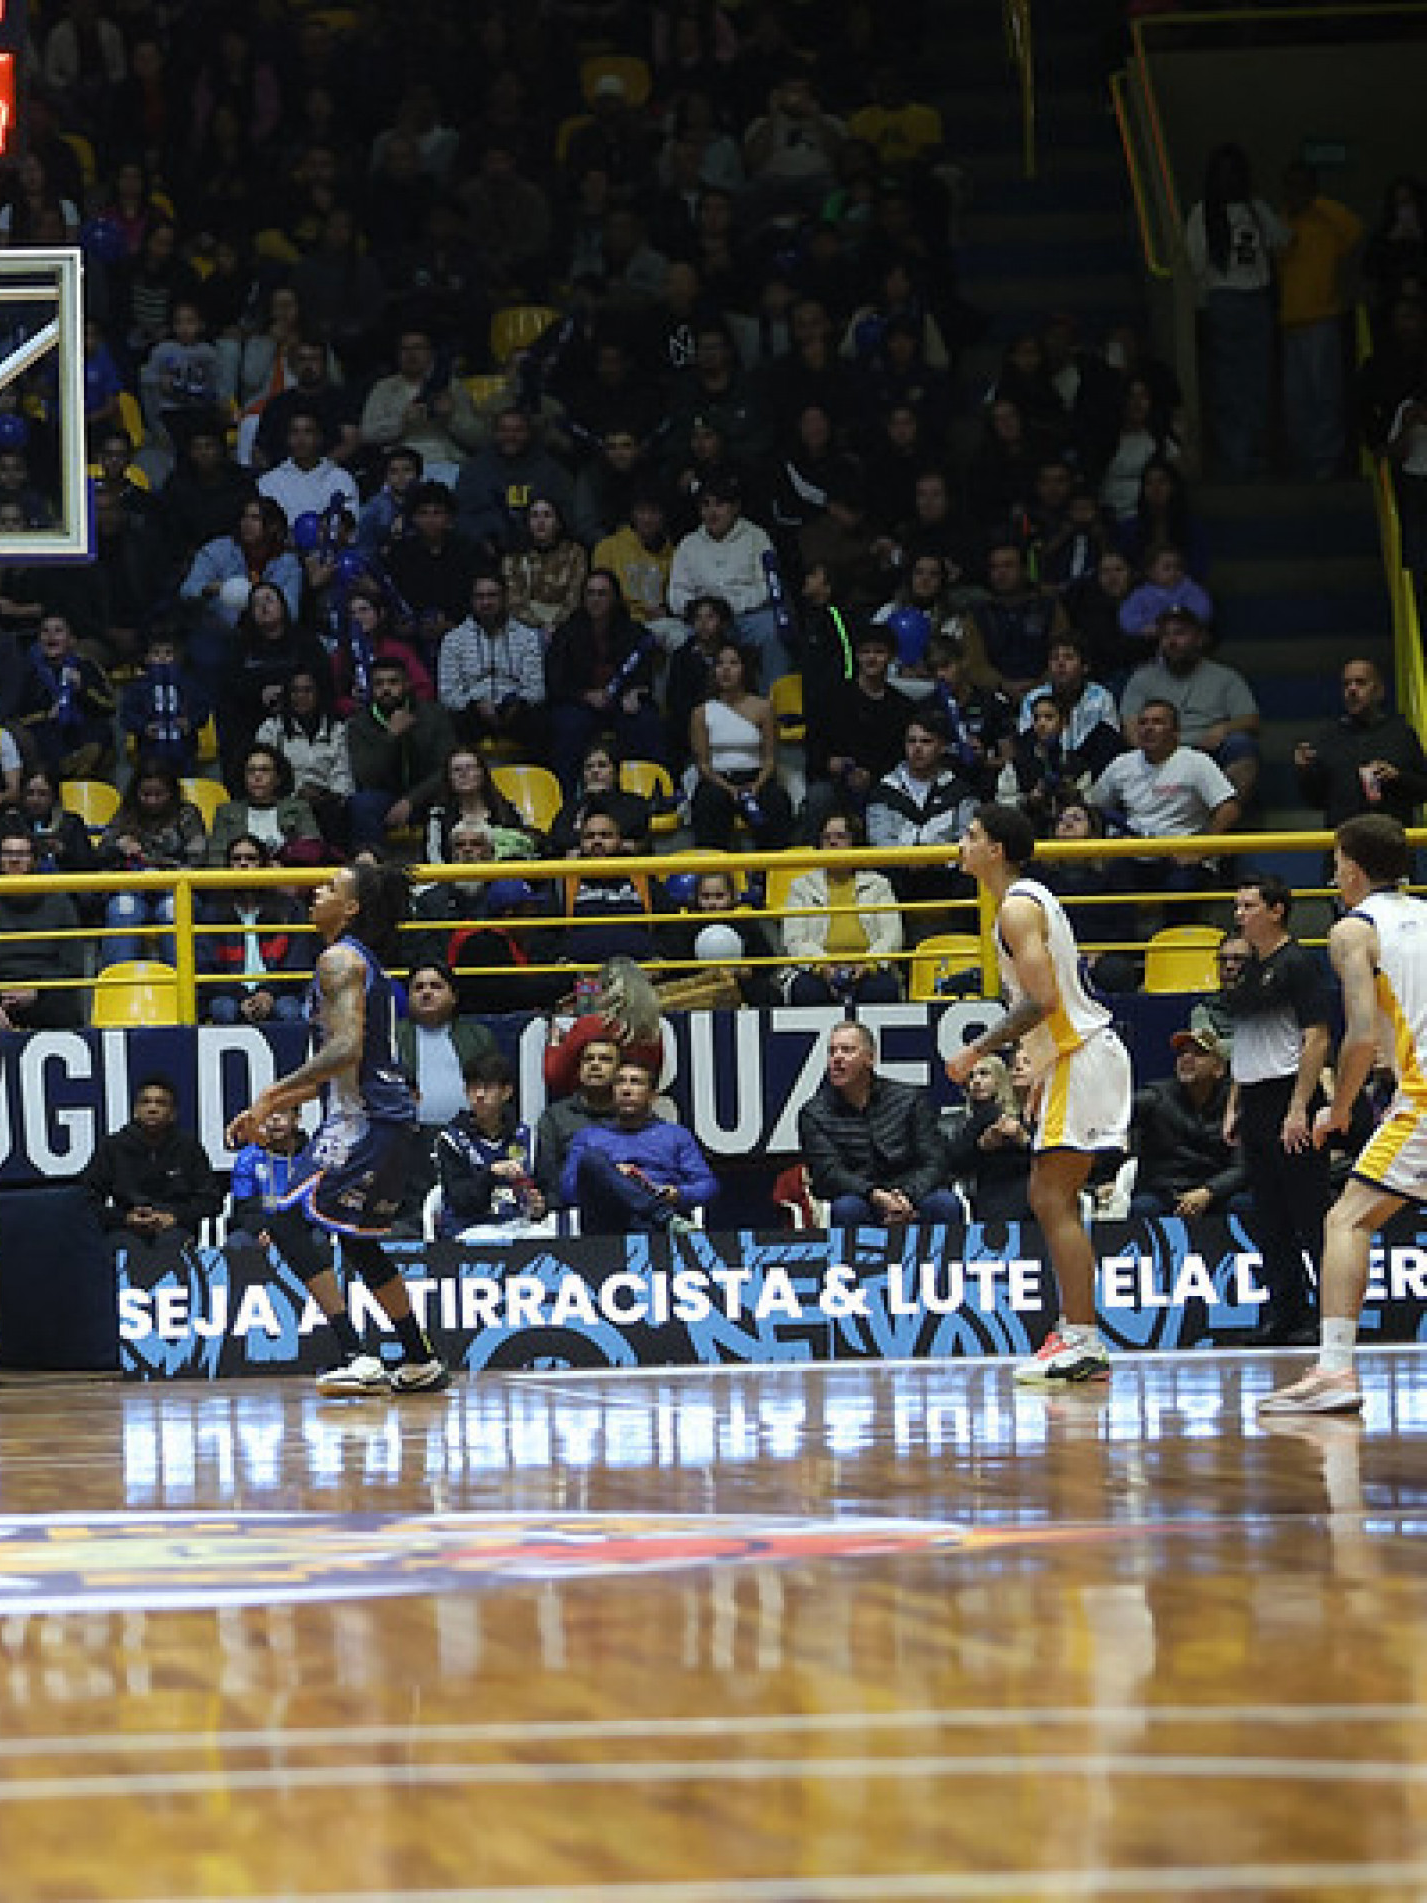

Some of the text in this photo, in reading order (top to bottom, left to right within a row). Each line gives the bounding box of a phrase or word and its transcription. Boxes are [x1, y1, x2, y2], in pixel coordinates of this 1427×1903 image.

[118, 1283, 282, 1342] SEJA
[298, 1268, 804, 1335] ANTIRRACISTA
[819, 1266, 874, 1319] &
[888, 1258, 1043, 1317] LUTE
